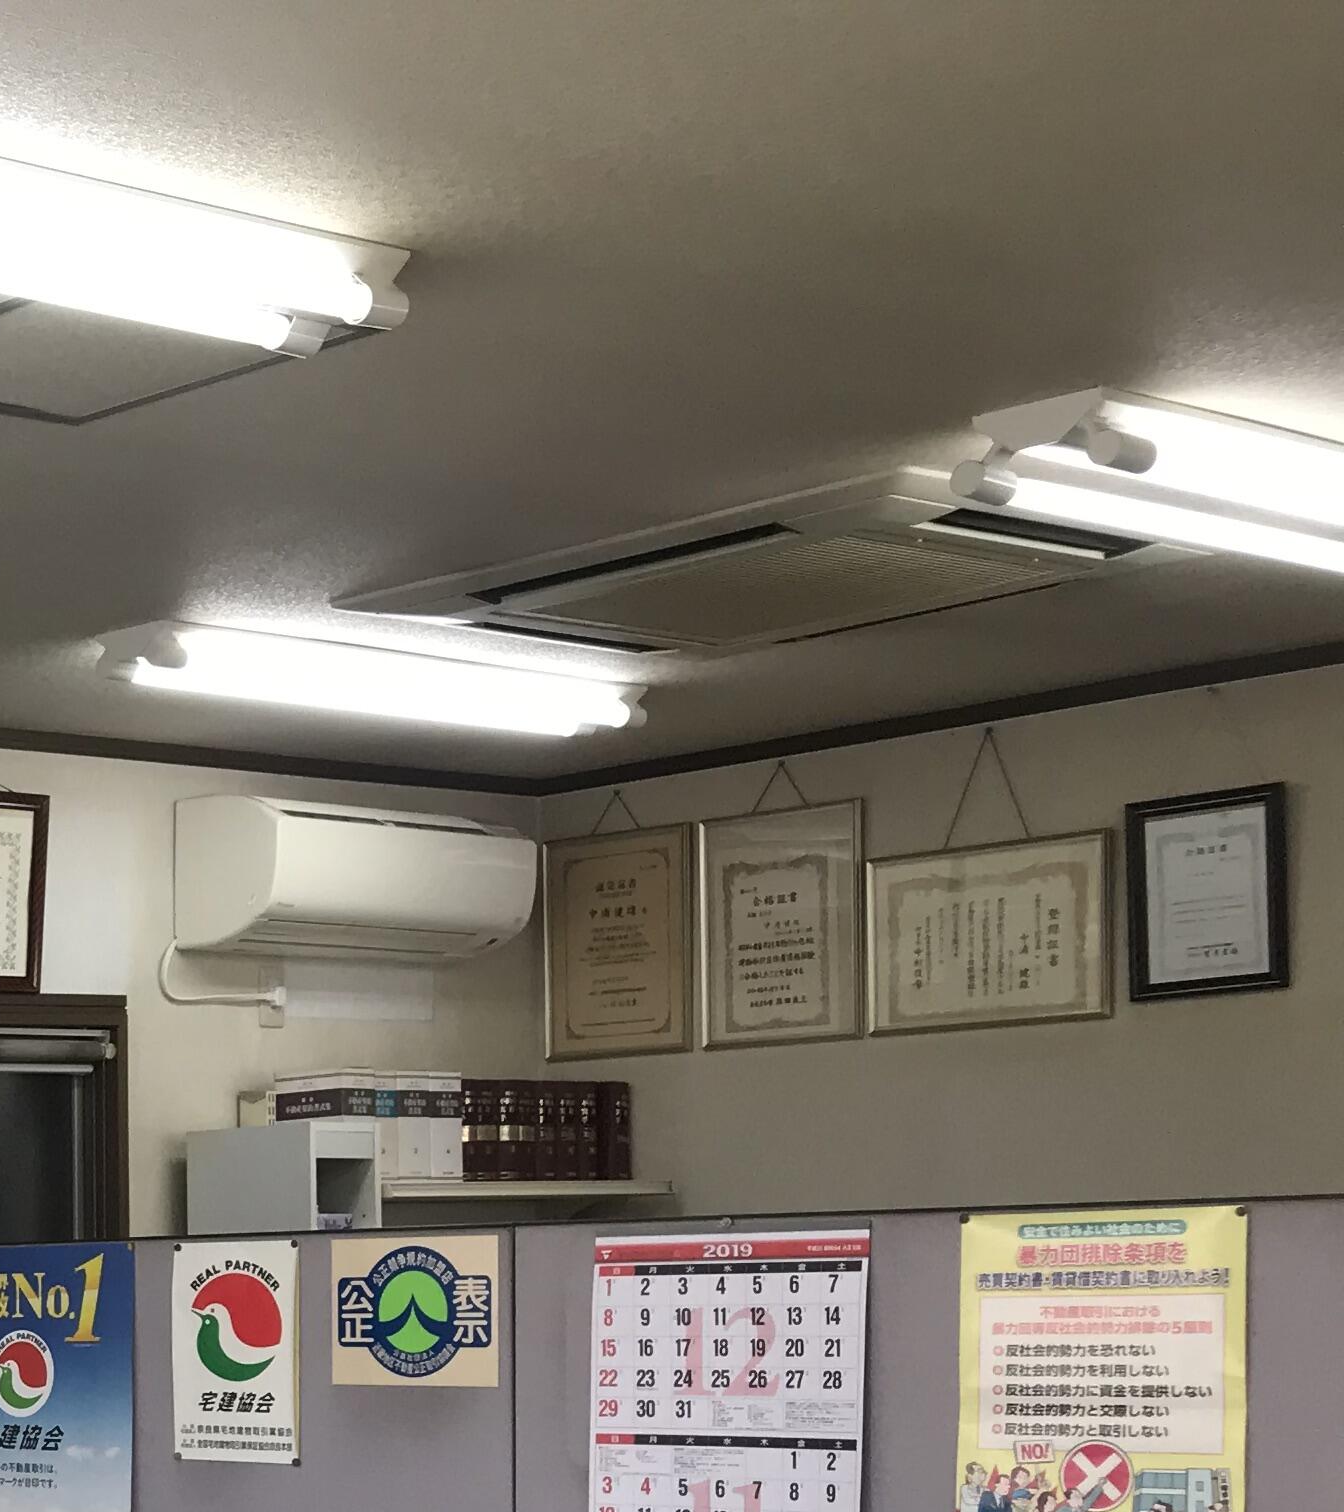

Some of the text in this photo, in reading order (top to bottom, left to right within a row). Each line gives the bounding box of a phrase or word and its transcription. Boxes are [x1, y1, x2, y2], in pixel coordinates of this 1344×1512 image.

[703, 1243, 753, 1258] 2019
[1016, 1242, 1186, 1266] 暴力団排除条項を
[190, 1260, 280, 1292] REAL PARTNER
[606, 1273, 839, 1296] 1 2 3 4 5 6 7
[341, 1280, 374, 1342] 公正
[453, 1277, 490, 1344] 表示
[603, 1305, 841, 1327] 8 9 10 11 12 13 14
[601, 1338, 841, 1358] 15 16 17 18 19 20 21
[673, 1305, 780, 1397] 12
[1005, 1344, 1156, 1358] 反社会的勢力を恐れない
[599, 1369, 842, 1390] 22 23 24 25 26 27 28
[1004, 1364, 1170, 1377] 反社会的勢力を利用しない
[1004, 1384, 1213, 1398] 反社会的勢力に資金を提供しない
[198, 1391, 276, 1413] 宅建協会
[598, 1399, 692, 1419] 29 30 31
[1004, 1404, 1170, 1418] 反社会的勢力と交際しない
[1004, 1423, 1169, 1438] 反社会的勢力と取引しない
[790, 1450, 837, 1471] 1 2
[1021, 1443, 1050, 1460] NO!
[602, 1476, 836, 1503] 3 4 5 6 7 8 9
